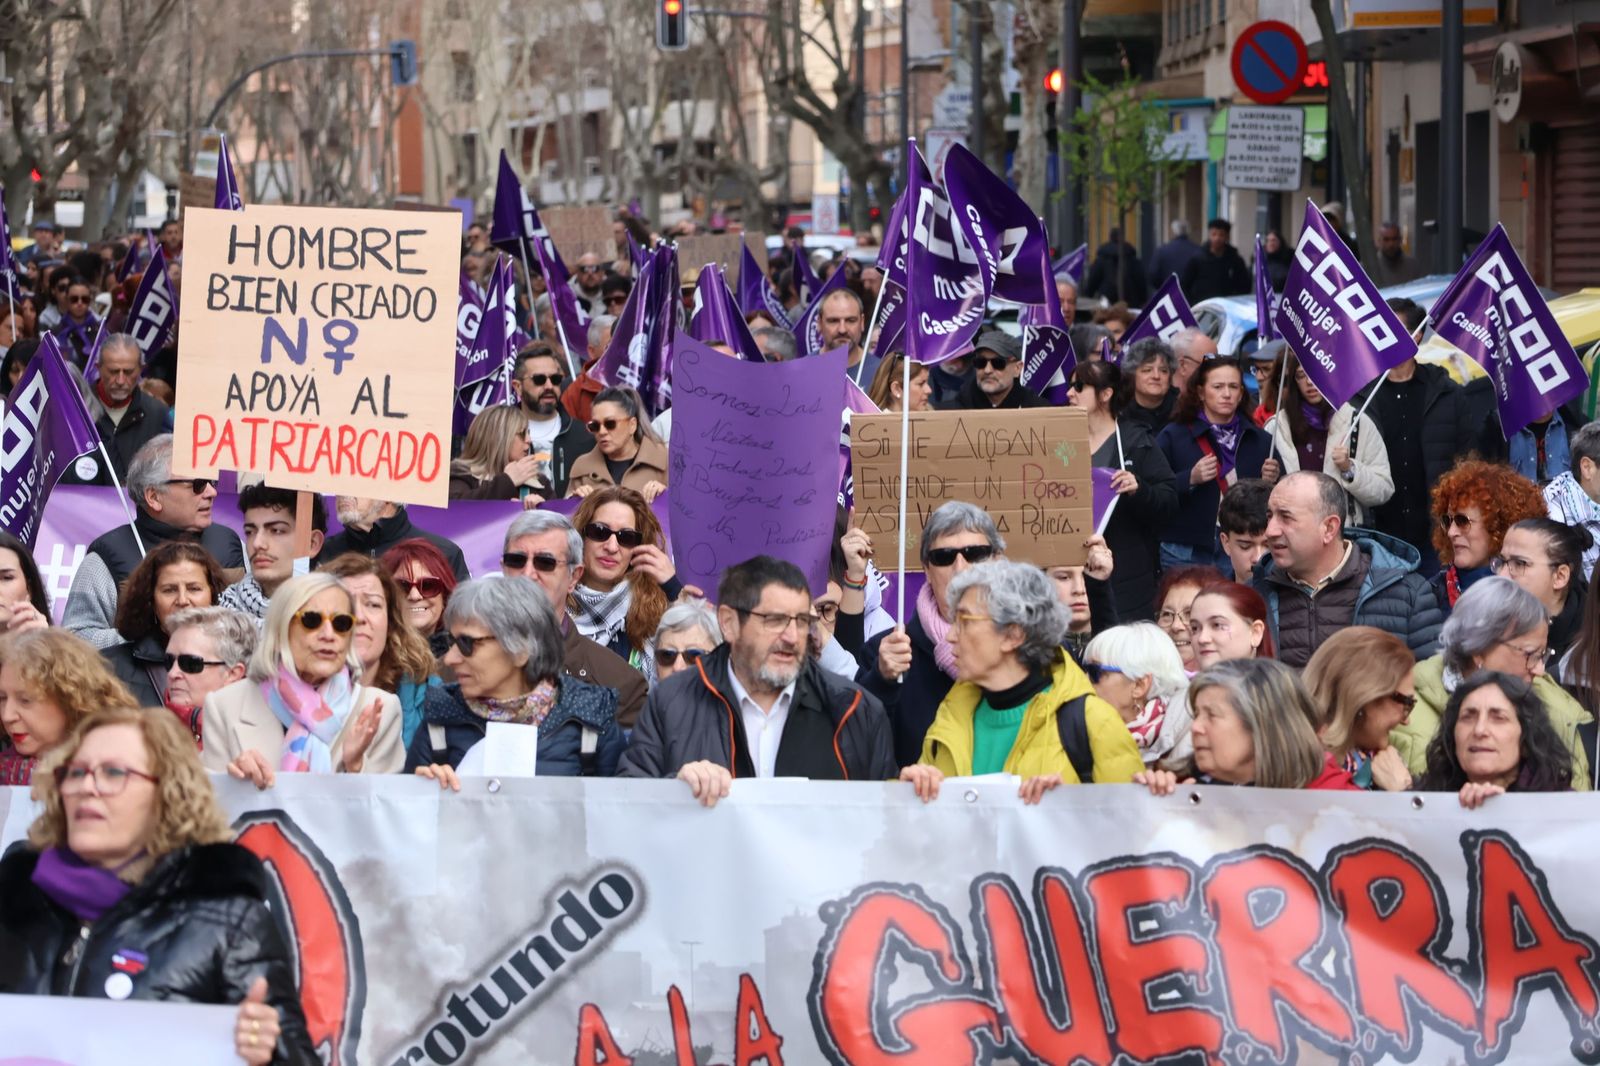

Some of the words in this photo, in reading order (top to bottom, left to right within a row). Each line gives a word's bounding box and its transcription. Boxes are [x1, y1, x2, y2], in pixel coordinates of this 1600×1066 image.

[228, 224, 427, 275] HOMBRE
[207, 273, 298, 315] BIEN
[310, 282, 438, 323] CRIADO
[1295, 226, 1398, 352] CCOO
[1298, 287, 1342, 337] mujer
[1281, 297, 1306, 340] Castilla
[1304, 332, 1312, 347] y
[1310, 344, 1337, 374] León
[1452, 310, 1495, 350] Castilla
[1490, 345, 1500, 360] y
[1475, 251, 1571, 396] CCOO
[1484, 304, 1514, 368] mujer
[225, 371, 320, 416] APOYA
[350, 374, 408, 419] AL
[678, 350, 761, 418] Somos
[192, 414, 442, 483] PATRIARCADO
[701, 419, 774, 451] Nietas
[691, 463, 783, 510] Brujas
[705, 447, 763, 480] Todas
[973, 475, 1002, 500] UN
[810, 829, 1600, 1066] GUERRA
